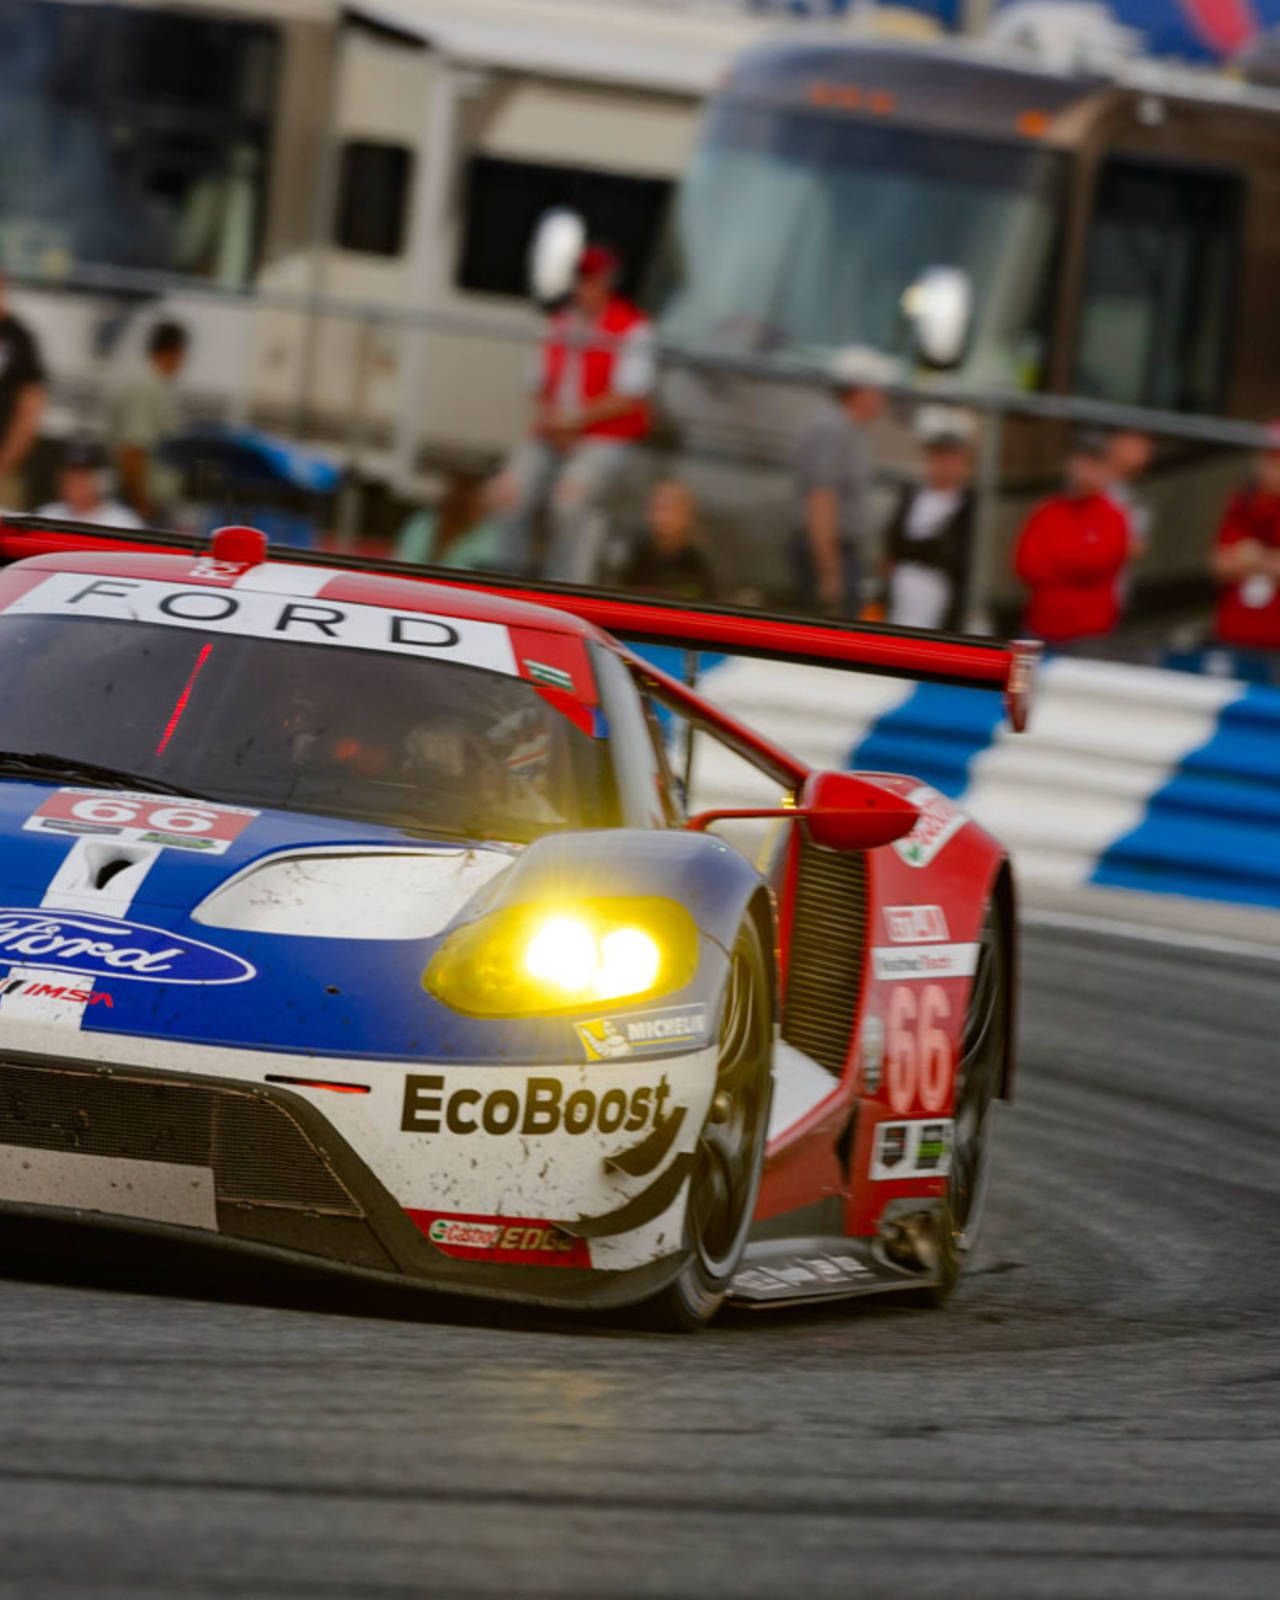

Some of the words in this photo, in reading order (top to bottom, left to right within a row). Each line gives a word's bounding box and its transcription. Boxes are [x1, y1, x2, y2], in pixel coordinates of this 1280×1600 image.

[64, 580, 461, 649] FORD
[71, 798, 219, 833] 66
[23, 983, 114, 1009] IMSA
[626, 1014, 705, 1042] MICHELIN
[886, 984, 952, 1115] 66
[400, 1072, 672, 1136] EcoBoost
